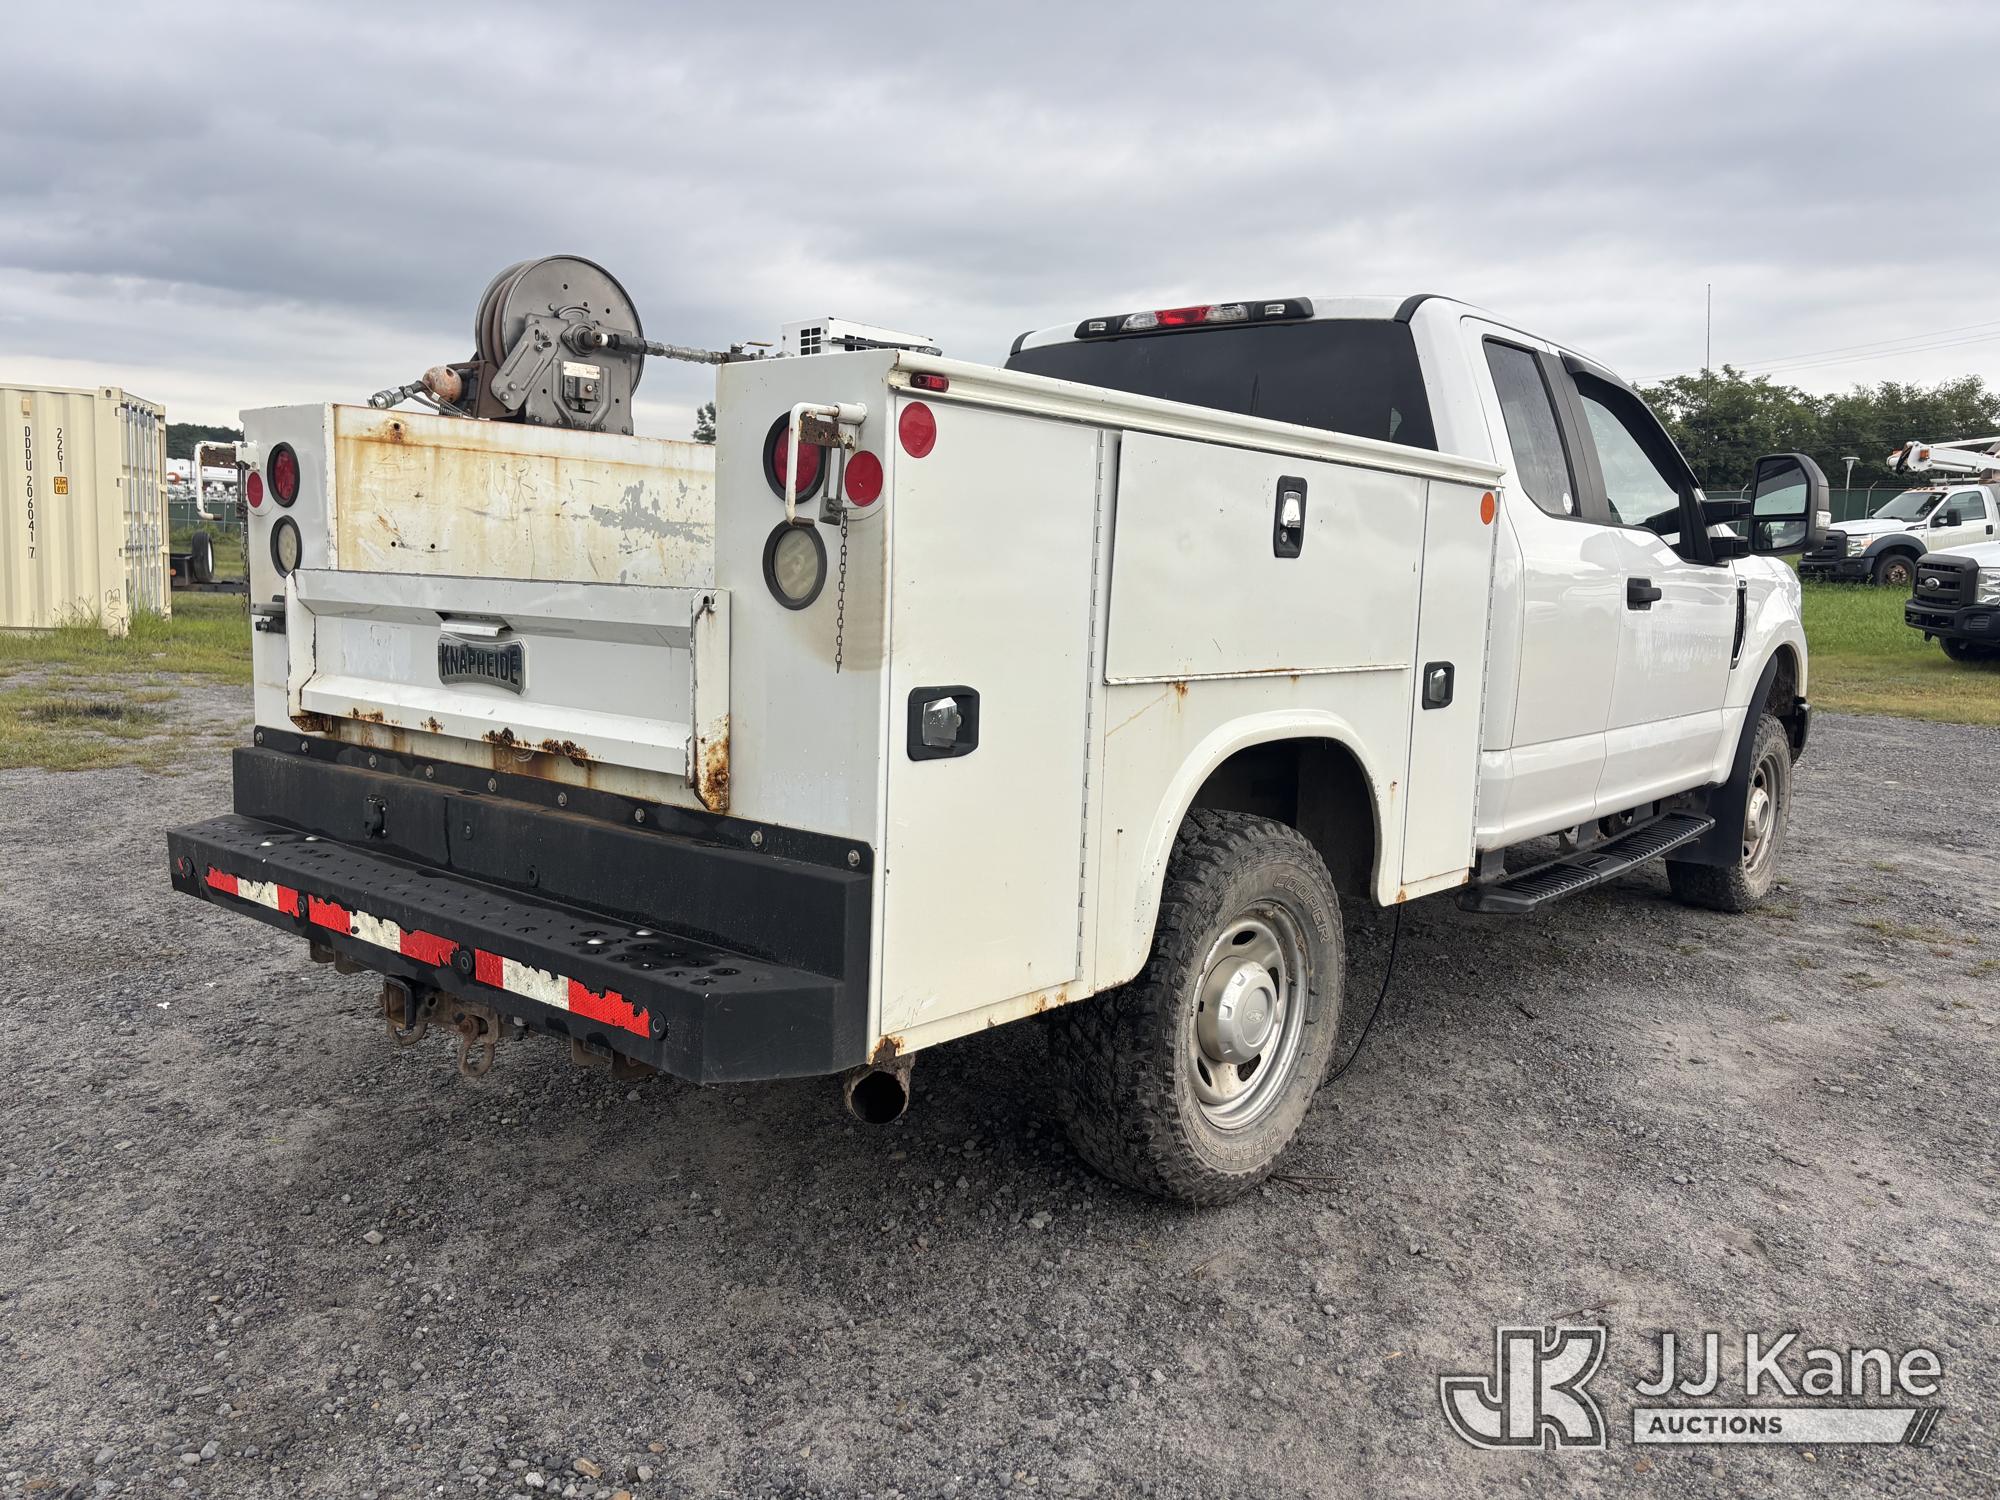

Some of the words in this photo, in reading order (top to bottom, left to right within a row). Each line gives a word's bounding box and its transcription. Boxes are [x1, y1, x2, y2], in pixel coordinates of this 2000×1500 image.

[24, 425, 32, 471] DDDU
[26, 475, 34, 543] 206041
[29, 546, 35, 559] 7
[441, 642, 521, 686] KNAPHEIDE
[1273, 873, 1330, 944] COOPER
